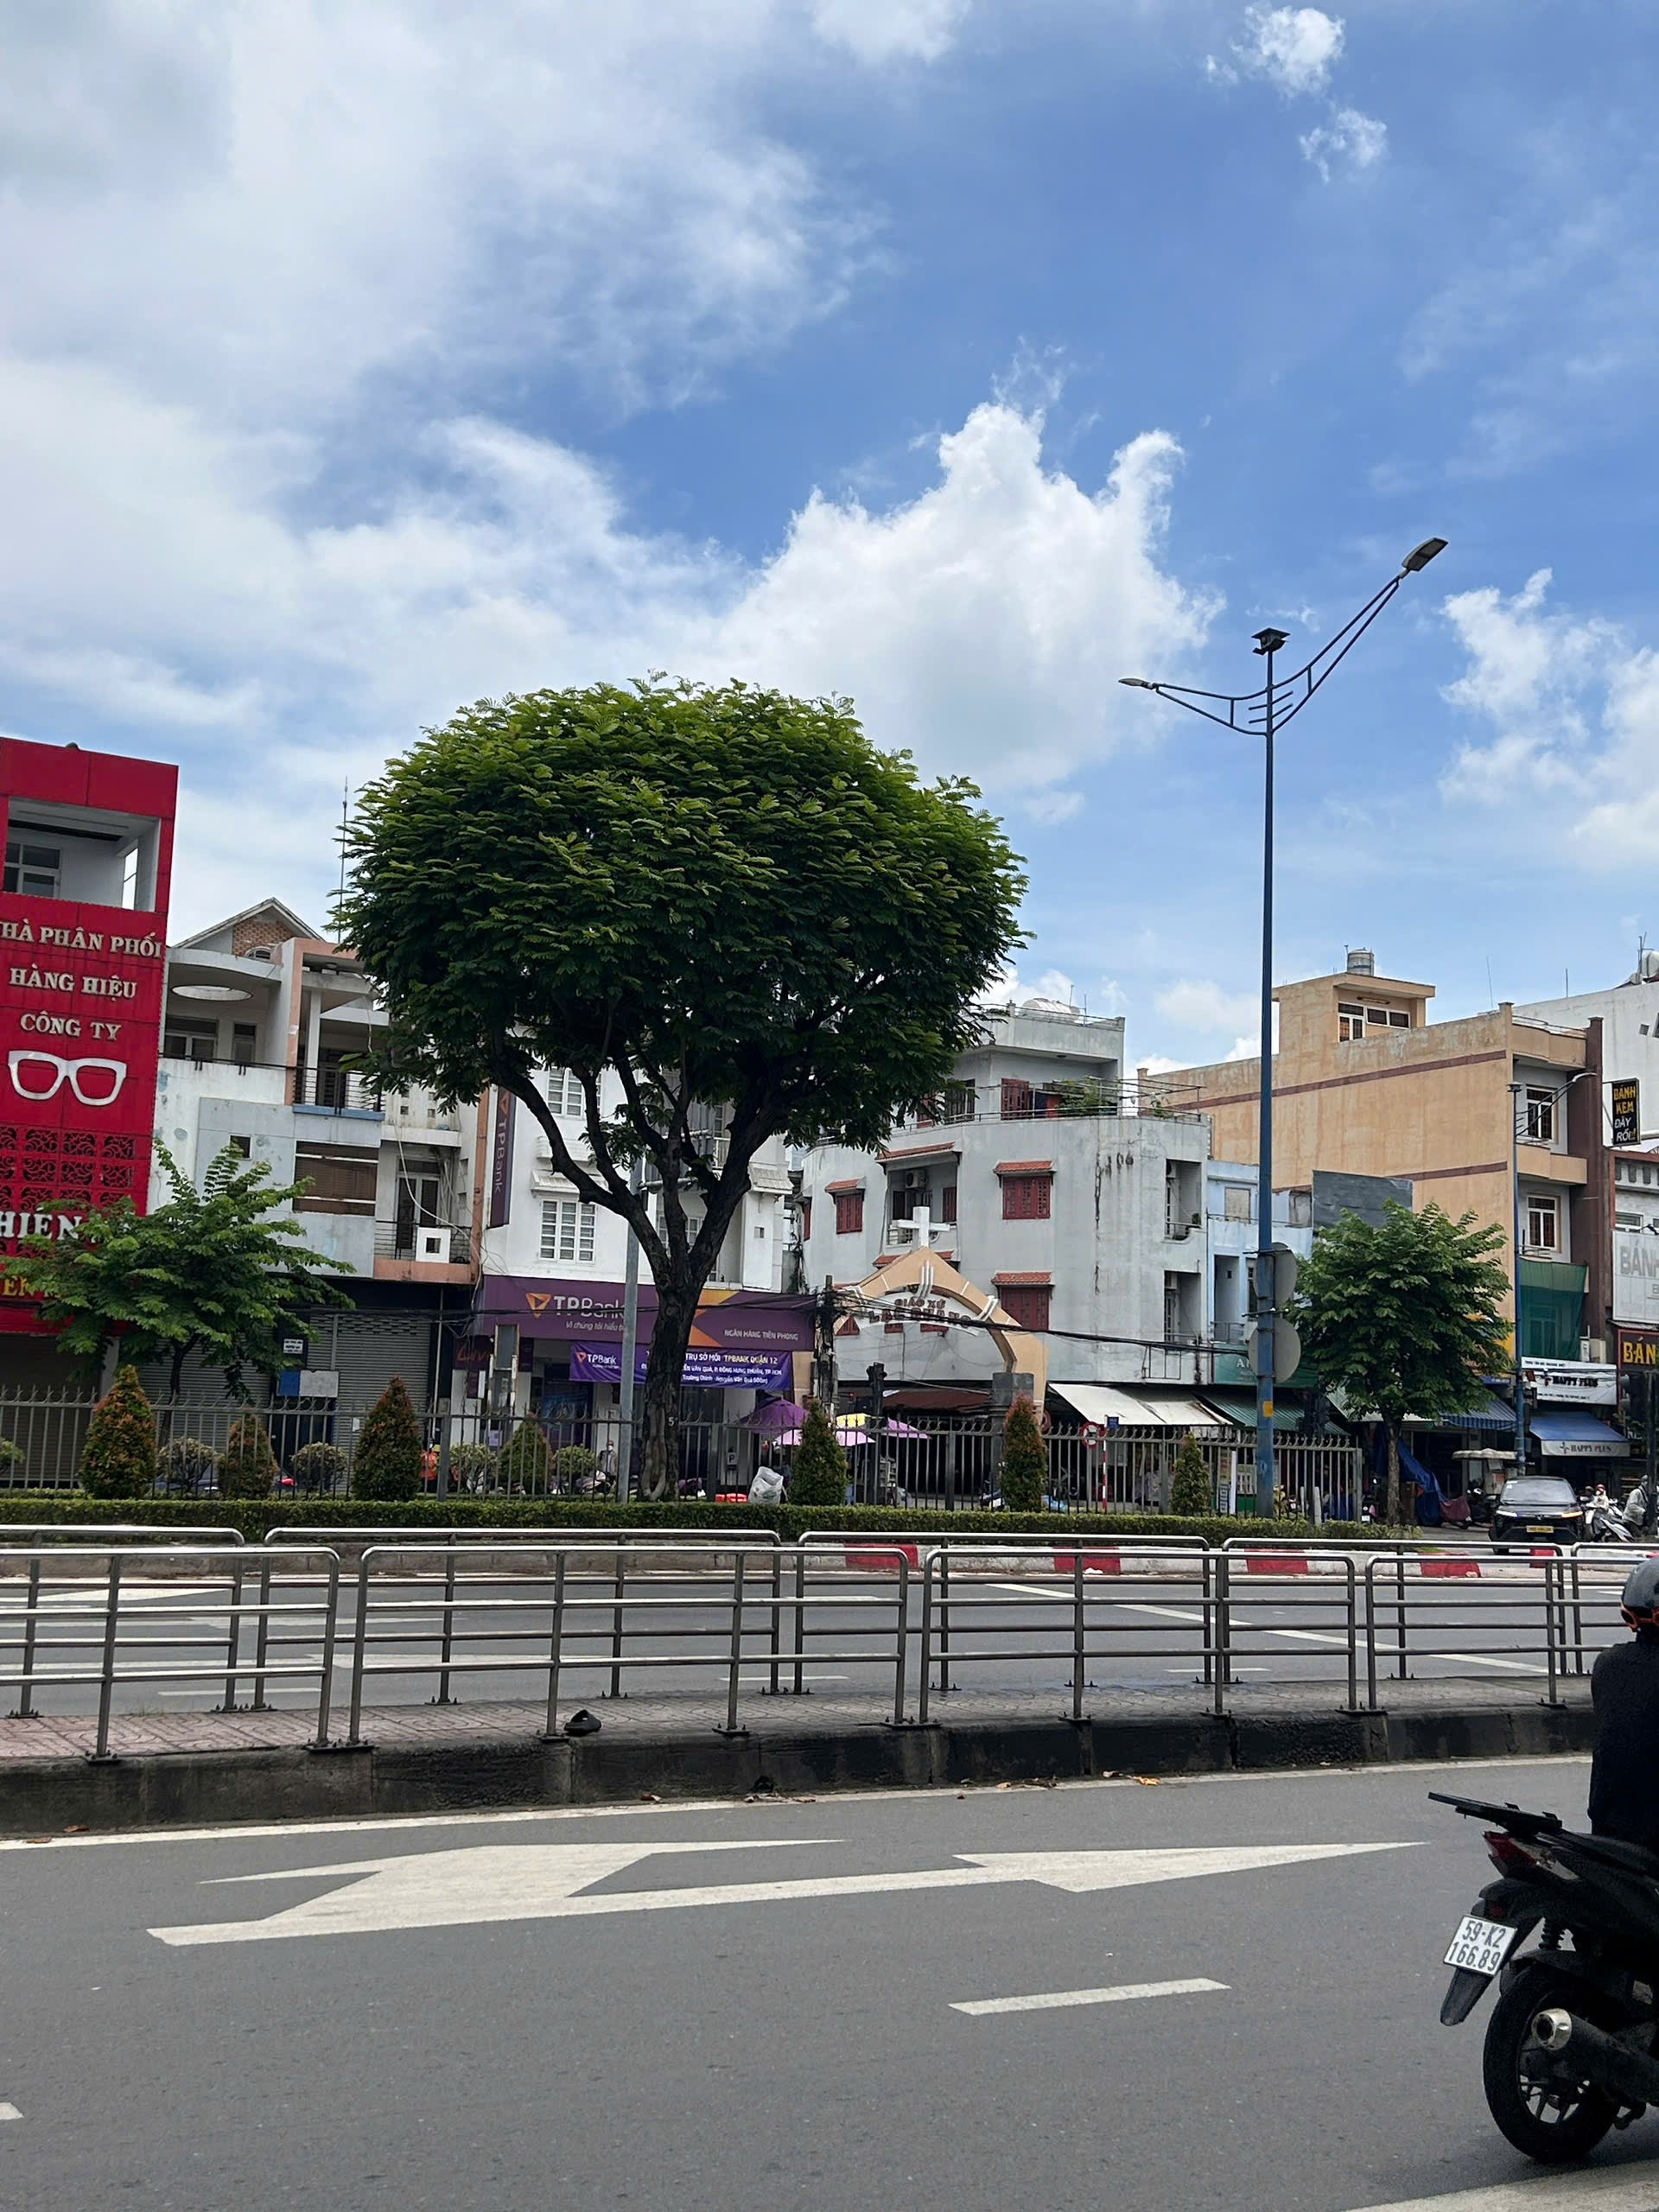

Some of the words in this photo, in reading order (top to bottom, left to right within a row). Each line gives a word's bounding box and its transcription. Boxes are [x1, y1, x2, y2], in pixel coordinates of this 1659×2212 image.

[0, 918, 35, 942] HÀ
[40, 926, 104, 951] PHÂN
[110, 931, 162, 958] PHỐI
[10, 963, 74, 992] HÀNG
[82, 975, 137, 1001] HIỆU
[20, 1010, 81, 1037] CÔNG
[90, 1021, 121, 1040] TY
[1613, 1084, 1636, 1101] BÁNH
[1616, 1101, 1634, 1115] KEM
[494, 1118, 507, 1193] TPBank
[554, 1295, 625, 1319] TPBank
[724, 1328, 742, 1338] NGÂN
[743, 1329, 760, 1338] HÀNG
[762, 1330, 776, 1339] TIÊN
[777, 1332, 798, 1341] PHONG
[587, 1353, 617, 1364] TPBank
[723, 1354, 750, 1363] TPBANK
[1570, 1444, 1592, 1452] HAPPY
[1461, 1920, 1507, 1948] 59-K2
[1448, 1942, 1501, 1972] 166.89
